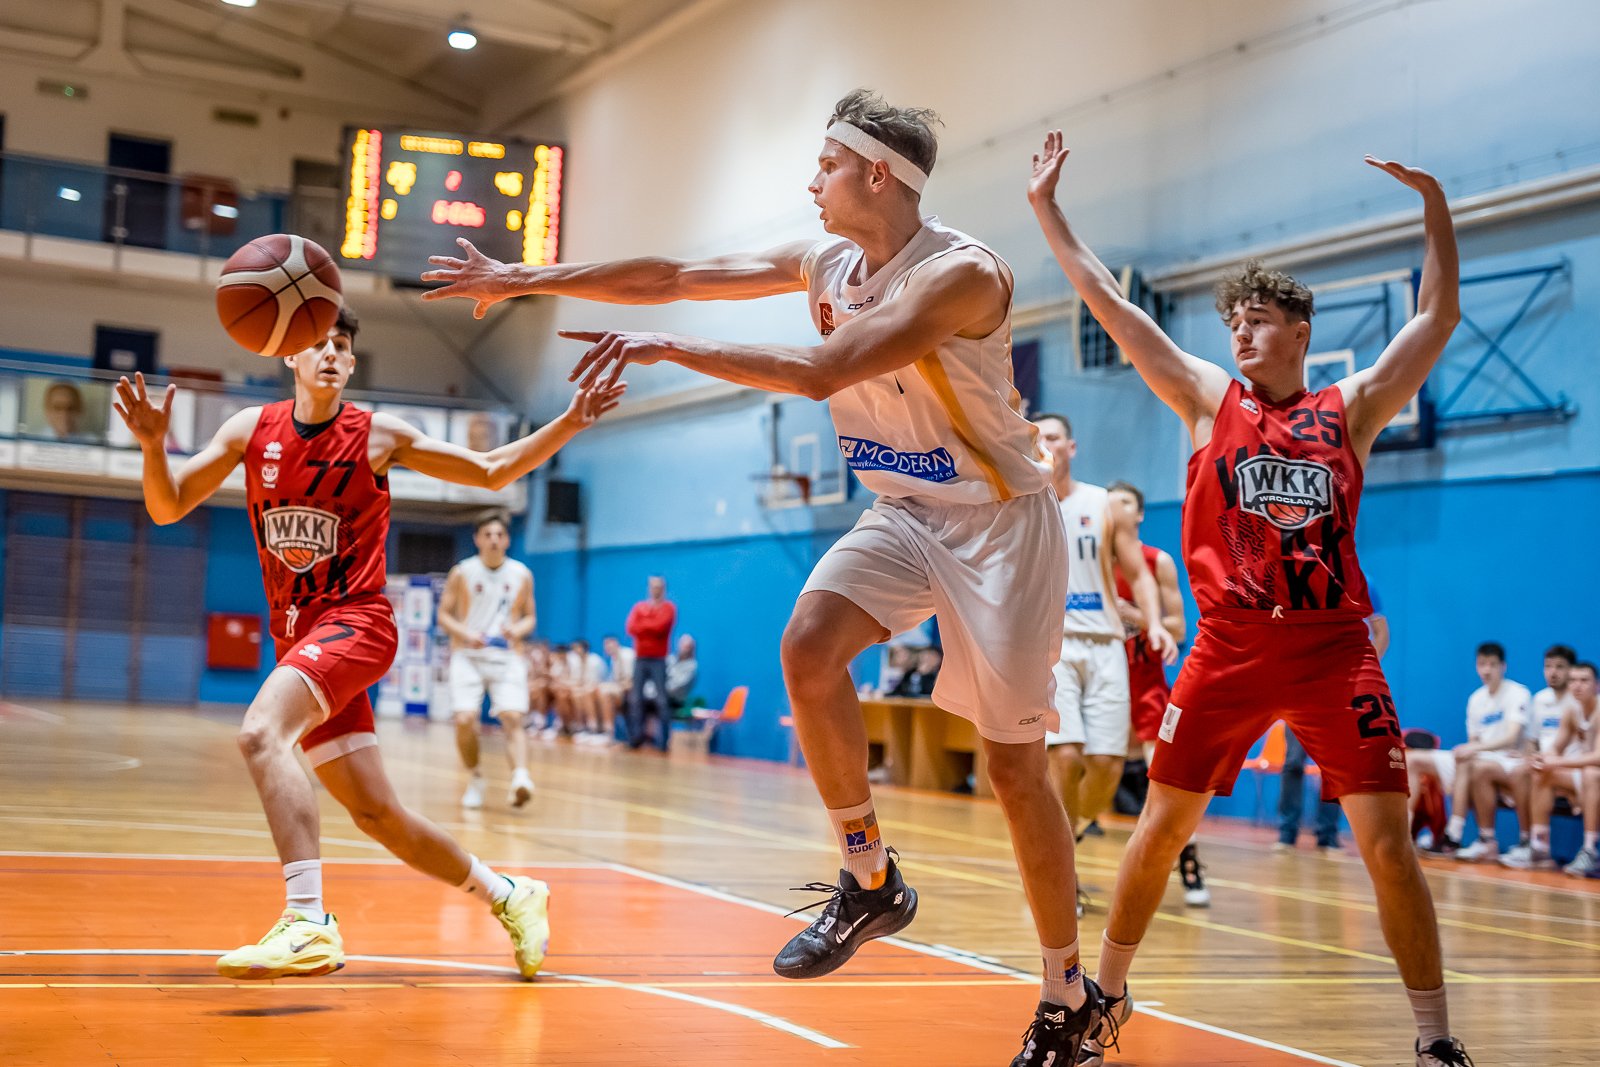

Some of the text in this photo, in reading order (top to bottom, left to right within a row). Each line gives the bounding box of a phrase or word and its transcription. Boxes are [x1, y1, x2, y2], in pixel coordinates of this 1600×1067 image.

[1288, 408, 1342, 448] 25
[857, 441, 952, 473] MODERN
[305, 460, 356, 497] 77
[1248, 464, 1320, 499] WKK
[272, 514, 326, 543] WKK
[1078, 535, 1096, 560] 17
